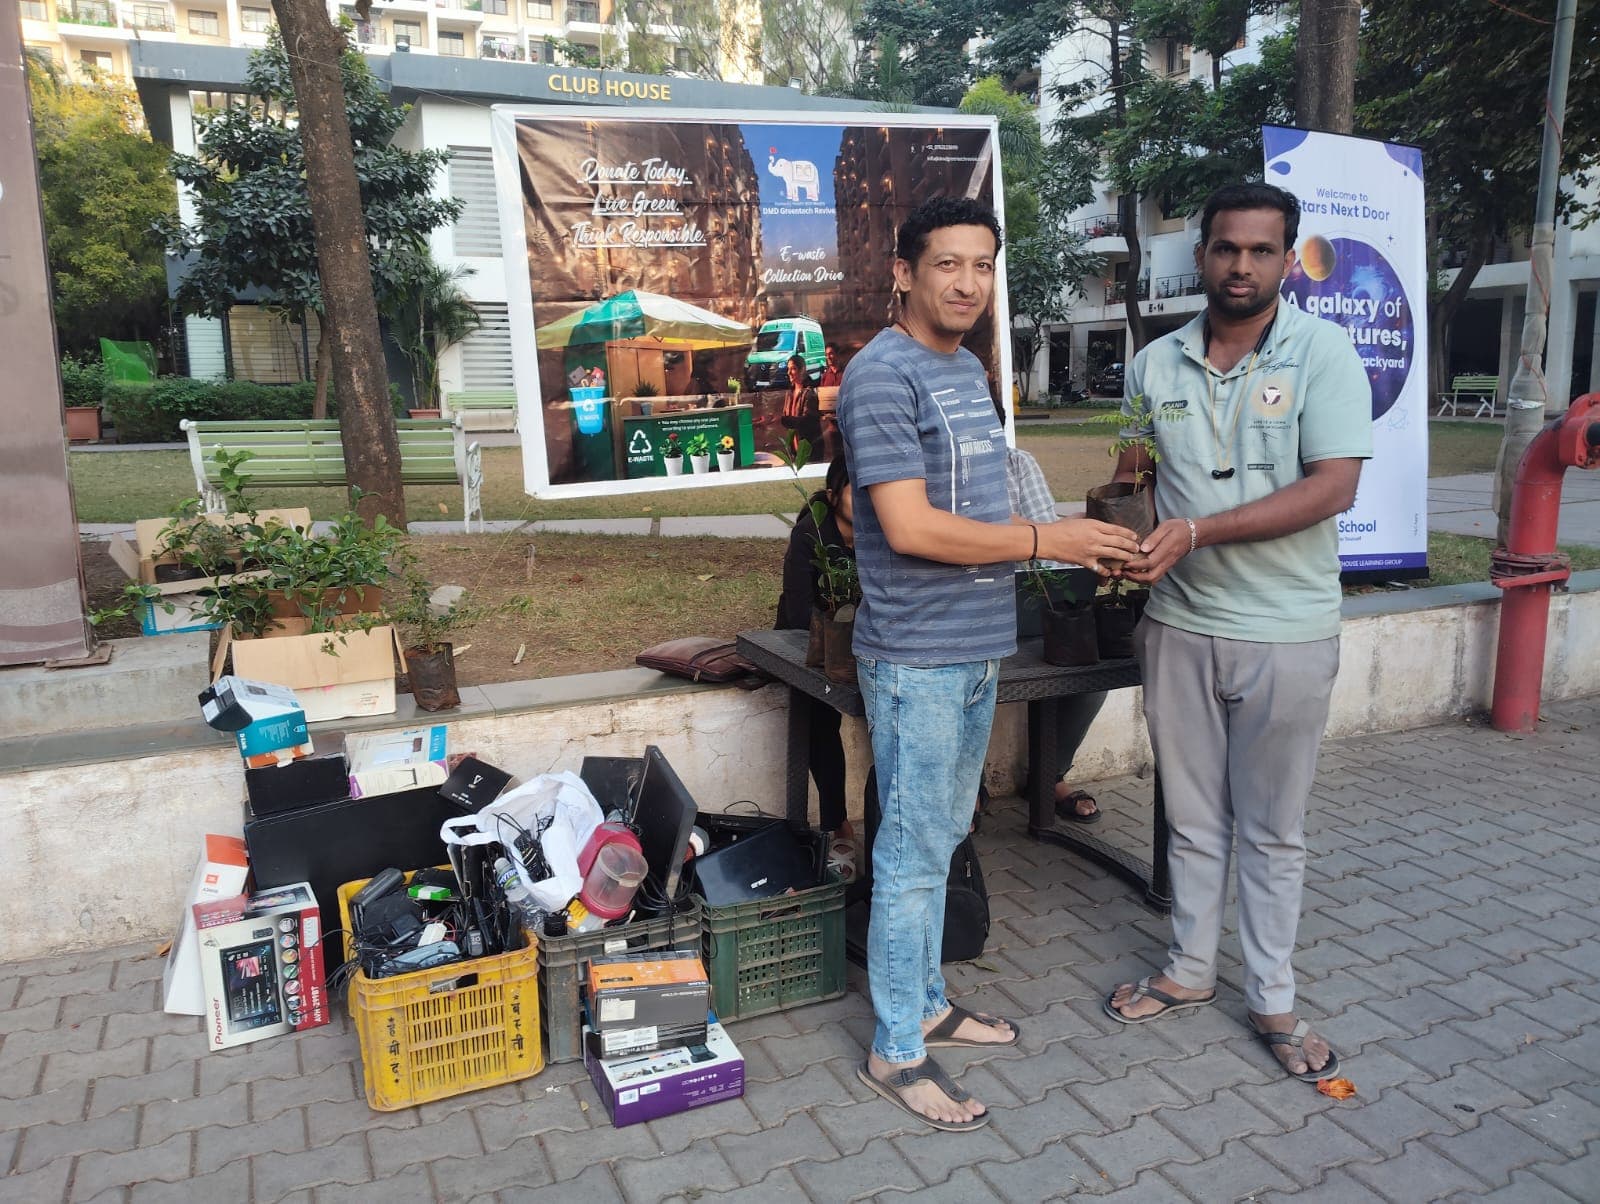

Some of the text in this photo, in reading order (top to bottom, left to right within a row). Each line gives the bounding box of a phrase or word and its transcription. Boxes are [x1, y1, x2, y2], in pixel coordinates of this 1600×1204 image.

[548, 74, 671, 101] CLUB HOUSE
[580, 157, 689, 186] Donate Today.
[592, 190, 680, 217] Live Green.
[1315, 187, 1369, 202] Welcome to
[762, 207, 779, 215] DMD
[1300, 199, 1390, 221] tars Next Door
[571, 221, 706, 247] Think Responsible.
[764, 266, 845, 284] Collection Drive
[1148, 302, 1164, 313] E-14
[1287, 291, 1402, 323] A galaxy of
[1348, 324, 1408, 351] tures,
[1361, 356, 1405, 371] ackyard
[1338, 519, 1377, 533] School
[213, 997, 223, 1045] Pioneer
